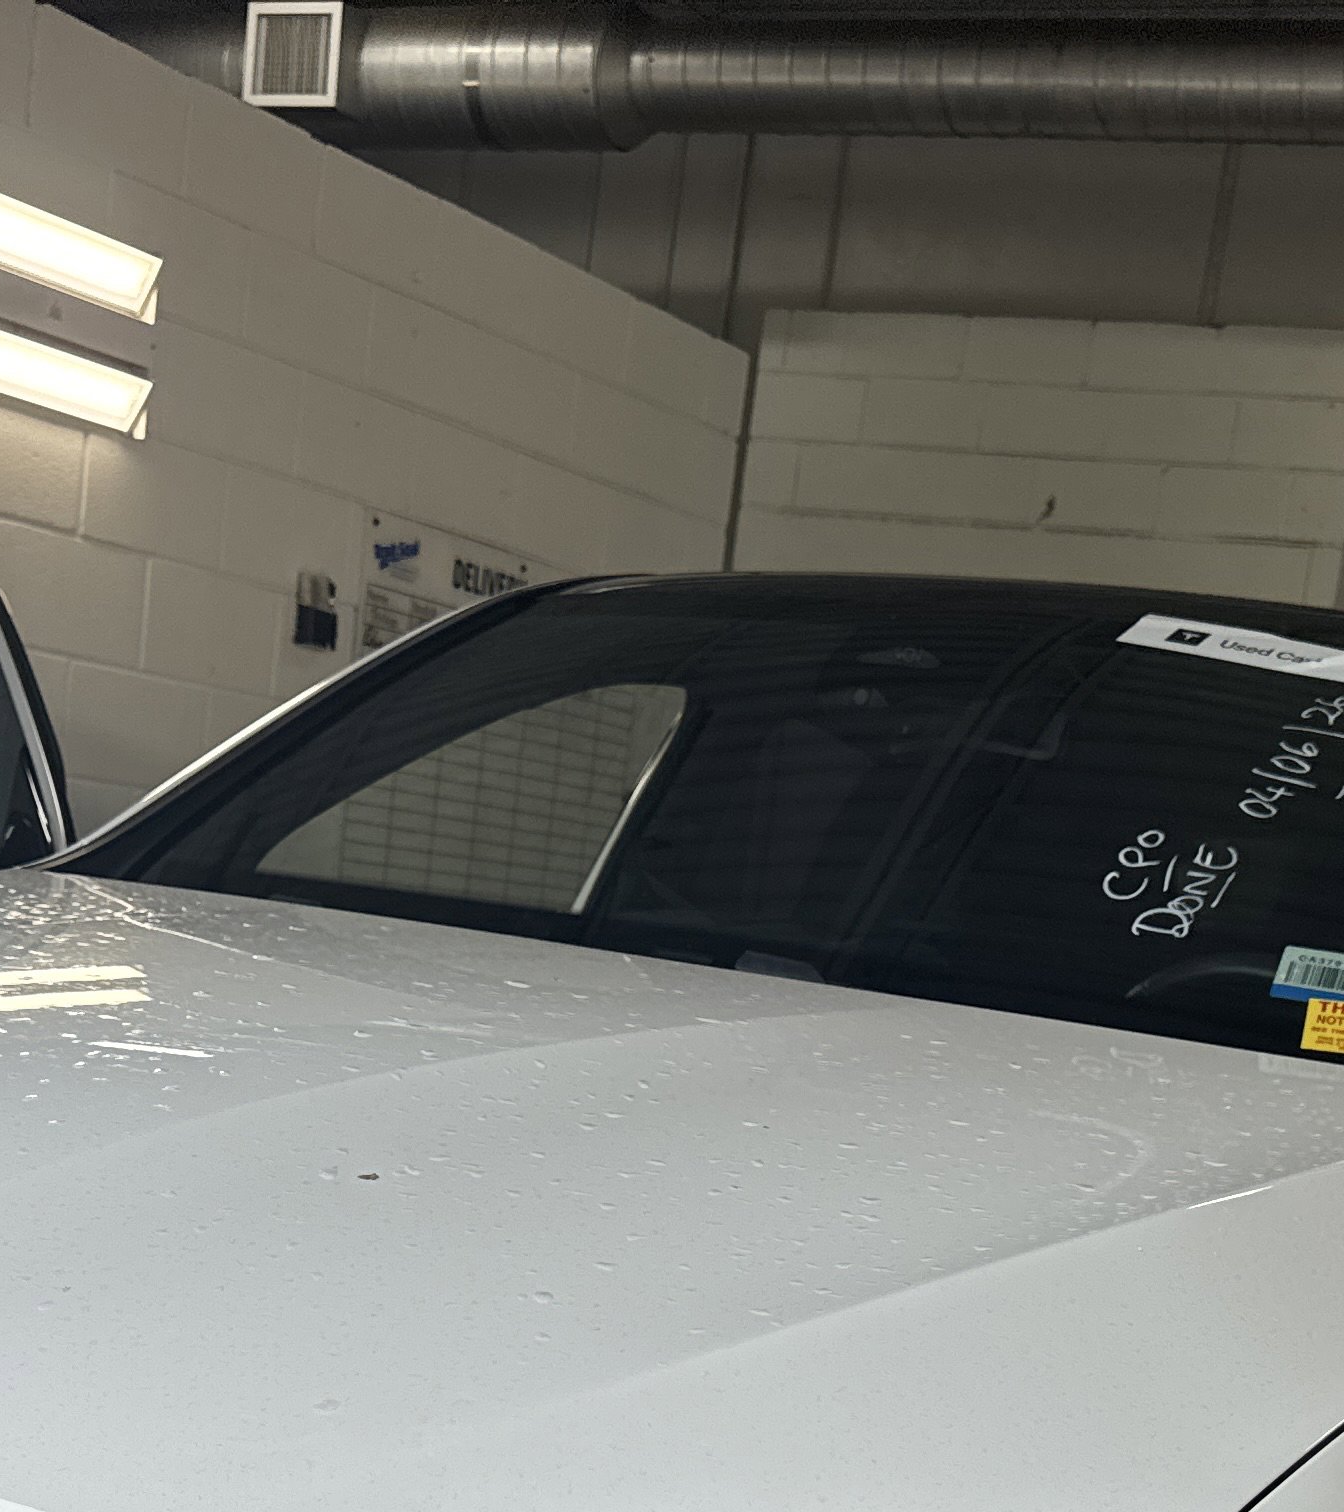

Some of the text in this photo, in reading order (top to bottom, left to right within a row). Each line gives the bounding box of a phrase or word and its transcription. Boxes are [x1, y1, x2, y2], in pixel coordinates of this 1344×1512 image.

[1220, 639, 1274, 657] Used
[1131, 844, 1238, 938] DONE
[1316, 1015, 1344, 1026] NOT
